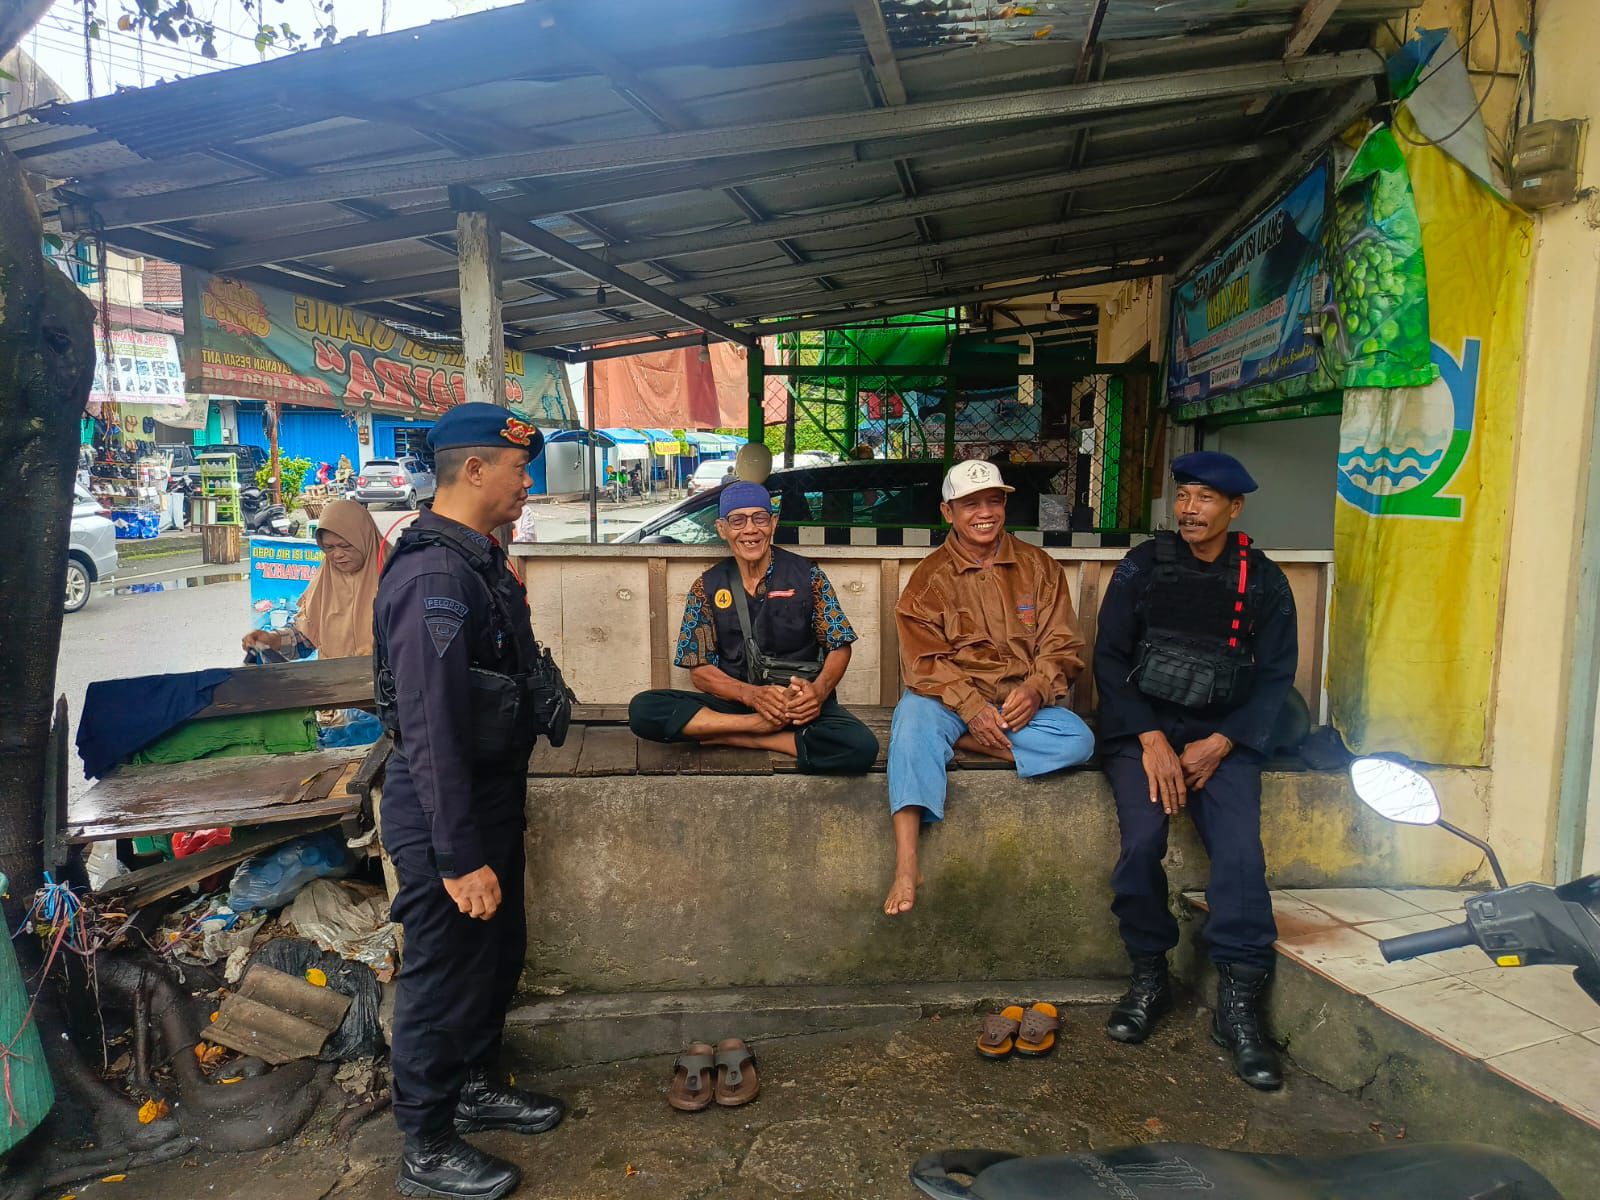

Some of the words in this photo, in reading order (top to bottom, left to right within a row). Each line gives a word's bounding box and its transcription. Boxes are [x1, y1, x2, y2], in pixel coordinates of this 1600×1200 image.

[1207, 270, 1250, 331] KHAYRA
[292, 549, 303, 560] ISI
[719, 593, 728, 604] 4
